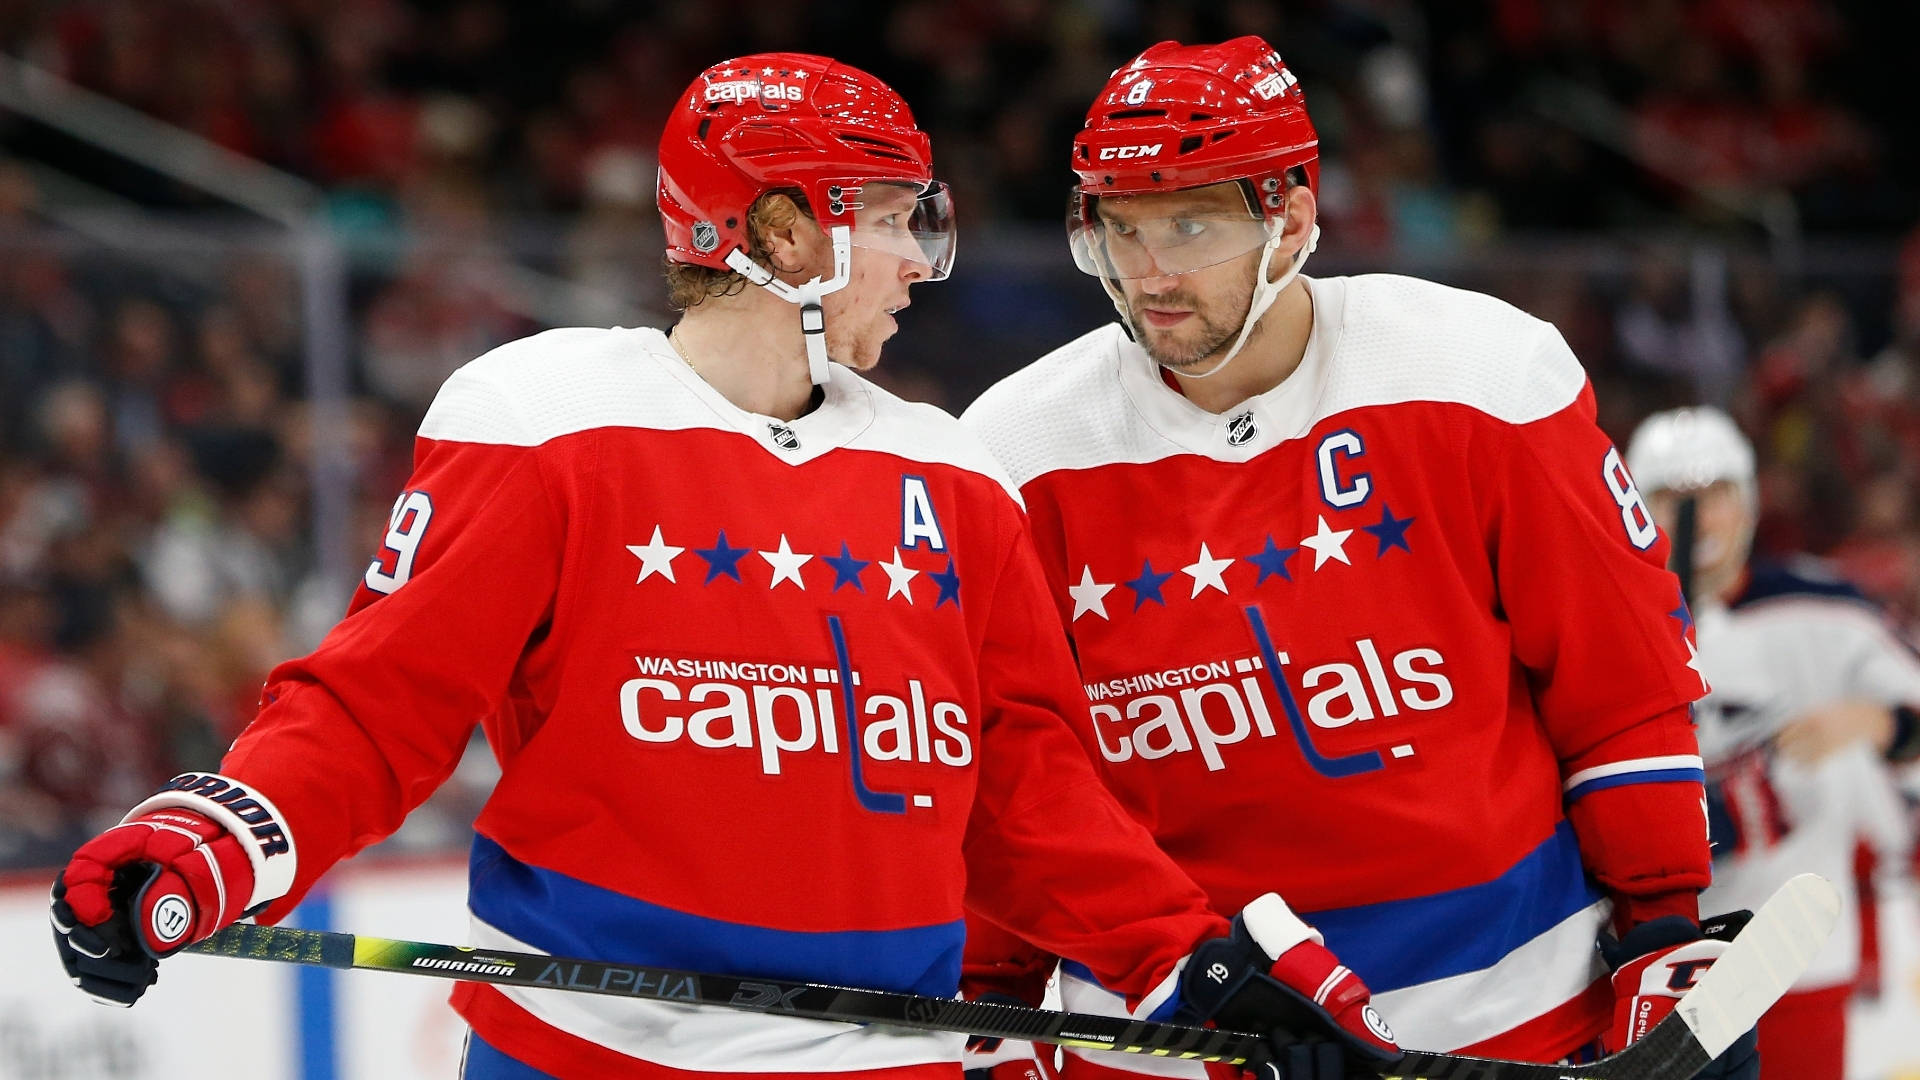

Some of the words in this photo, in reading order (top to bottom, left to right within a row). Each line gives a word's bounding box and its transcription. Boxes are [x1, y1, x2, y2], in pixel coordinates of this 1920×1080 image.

[1126, 78, 1153, 106] 8
[1099, 144, 1163, 160] CCM
[1315, 428, 1374, 511] C
[901, 474, 949, 553] A
[1602, 445, 1659, 551] 8
[634, 655, 807, 684] WASHINGTON
[1084, 660, 1231, 701] WASHINGTON
[155, 774, 289, 862] RRIOR
[412, 957, 516, 977] WARRIOR
[532, 961, 697, 1001] ALPHA
[1206, 962, 1229, 985] 19
